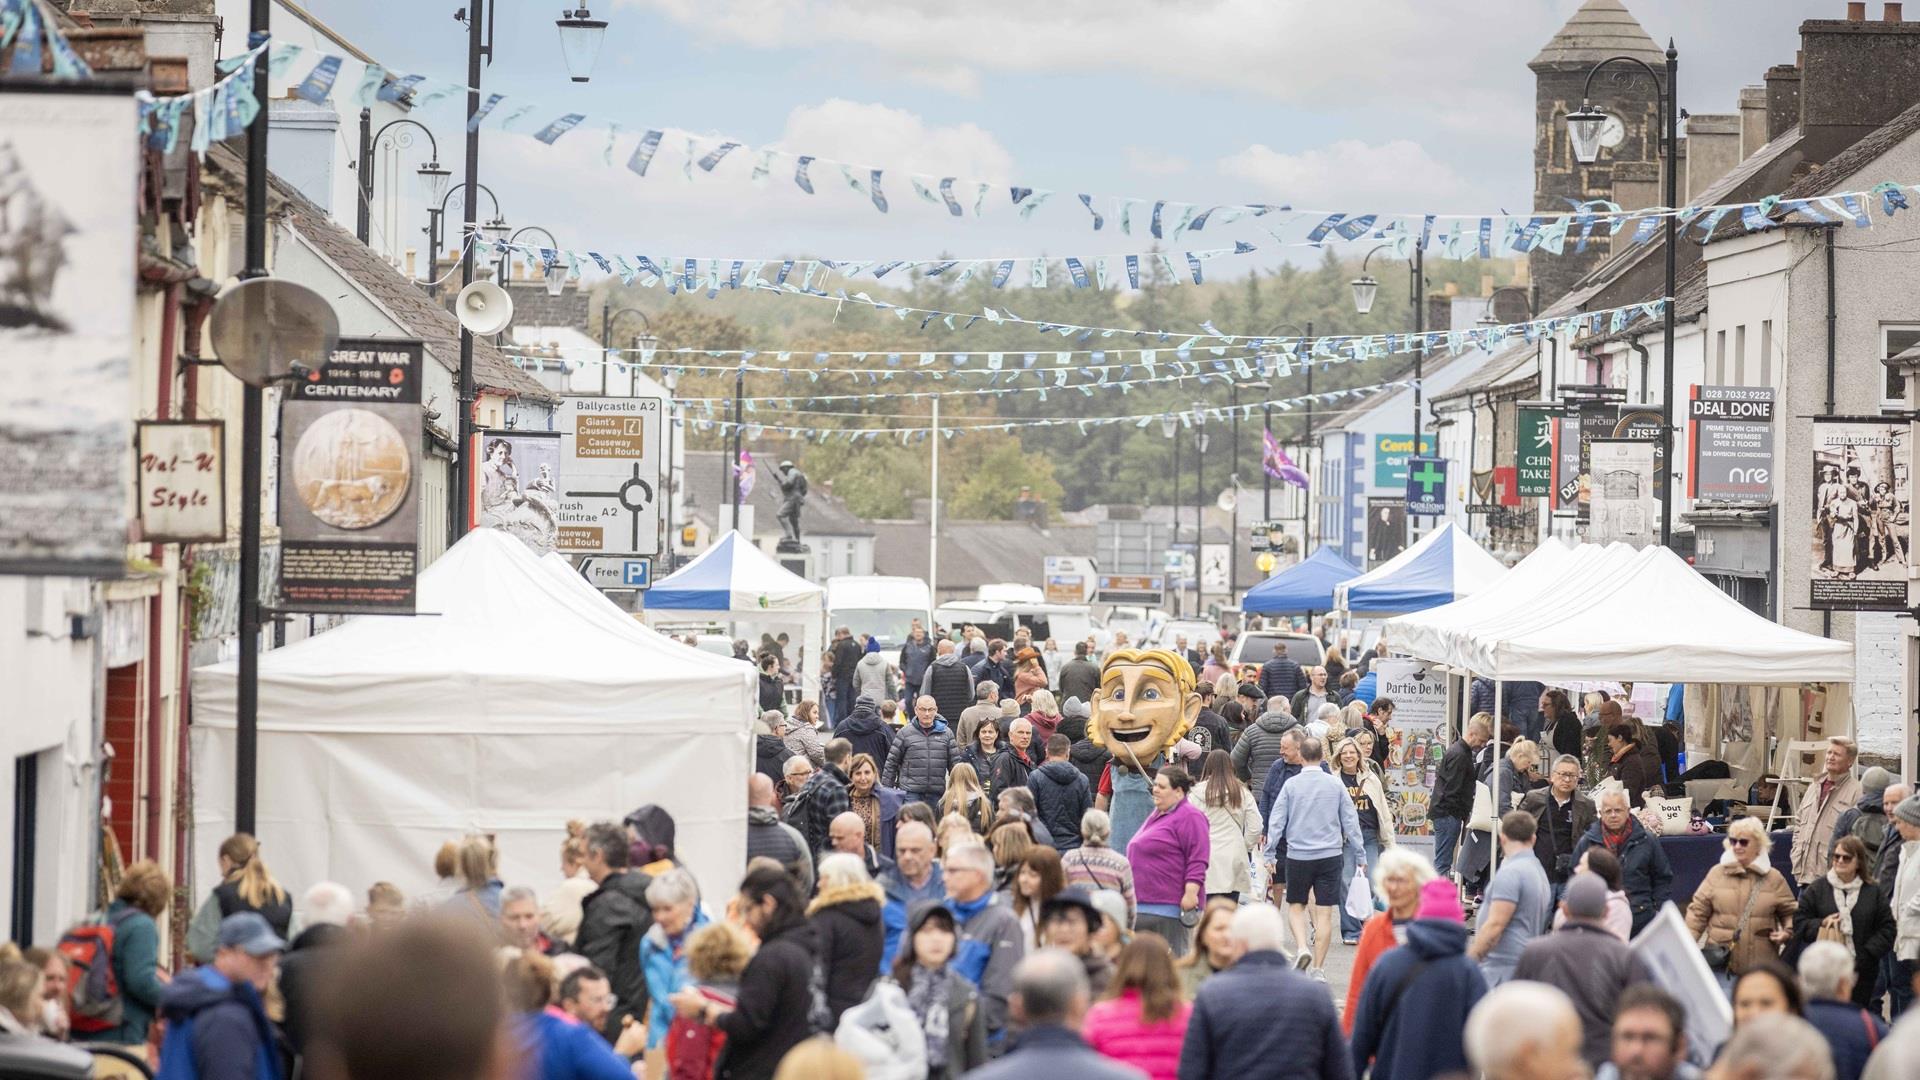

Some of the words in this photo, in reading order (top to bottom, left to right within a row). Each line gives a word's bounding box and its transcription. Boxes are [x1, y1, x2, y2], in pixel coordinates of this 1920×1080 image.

[329, 350, 374, 363] GREAT
[378, 352, 410, 364] WAR
[328, 369, 349, 378] 1914
[359, 370, 381, 379] 1918
[304, 384, 402, 397] CENTENARY
[1706, 390, 1722, 399] 028
[1725, 391, 1747, 399] 7032
[1749, 391, 1771, 400] 9222
[577, 401, 636, 412] Ballycastle
[1694, 401, 1727, 415] DEAL
[1731, 402, 1770, 416] DONE
[586, 417, 615, 426] Giant's
[579, 427, 621, 436] Causeway
[1628, 428, 1661, 439] FISH
[588, 438, 631, 448] Causeway
[1380, 438, 1428, 453] Centa
[579, 447, 612, 456] Coastal
[615, 447, 641, 456] Route
[1525, 456, 1552, 466] CHIN
[1729, 467, 1769, 484] nre
[1560, 479, 1580, 500] DEA
[150, 487, 207, 511] Style
[559, 502, 583, 510] rush
[558, 512, 598, 521] llintrae
[575, 539, 601, 547] Route
[595, 567, 619, 576] Free
[628, 563, 643, 583] P
[1386, 682, 1416, 694] Partie
[1419, 683, 1431, 695] De
[1659, 803, 1682, 811] 'bout
